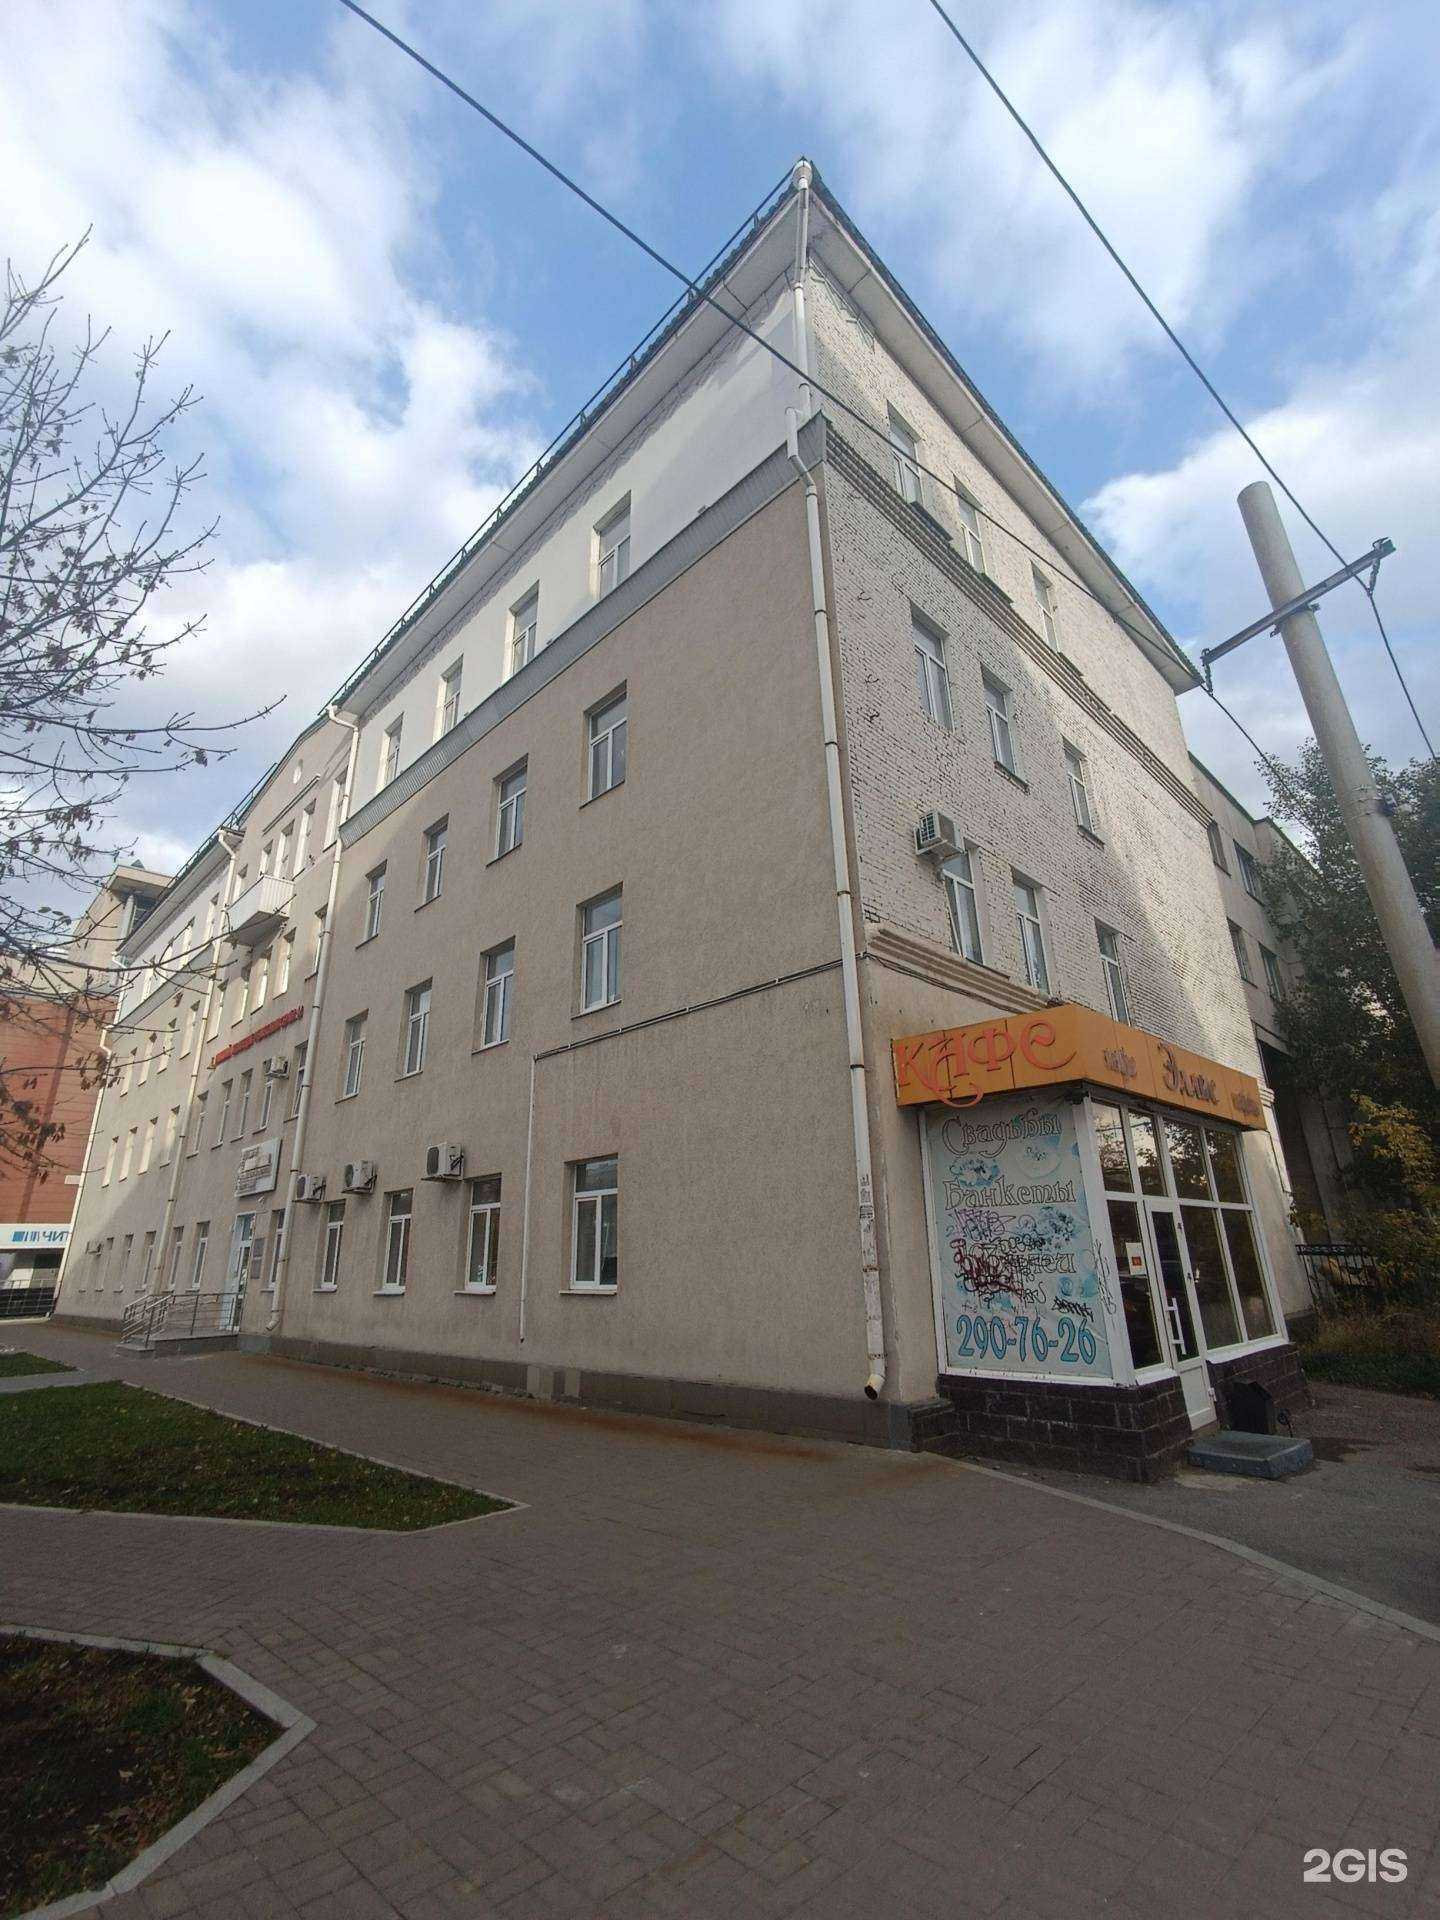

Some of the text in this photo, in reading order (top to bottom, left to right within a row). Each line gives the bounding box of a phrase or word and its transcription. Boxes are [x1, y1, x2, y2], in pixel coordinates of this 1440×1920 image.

[942, 1107, 1062, 1158] Свадьбы
[943, 1174, 1077, 1210] Банкеты
[956, 1314, 1097, 1365] 290-76-26
